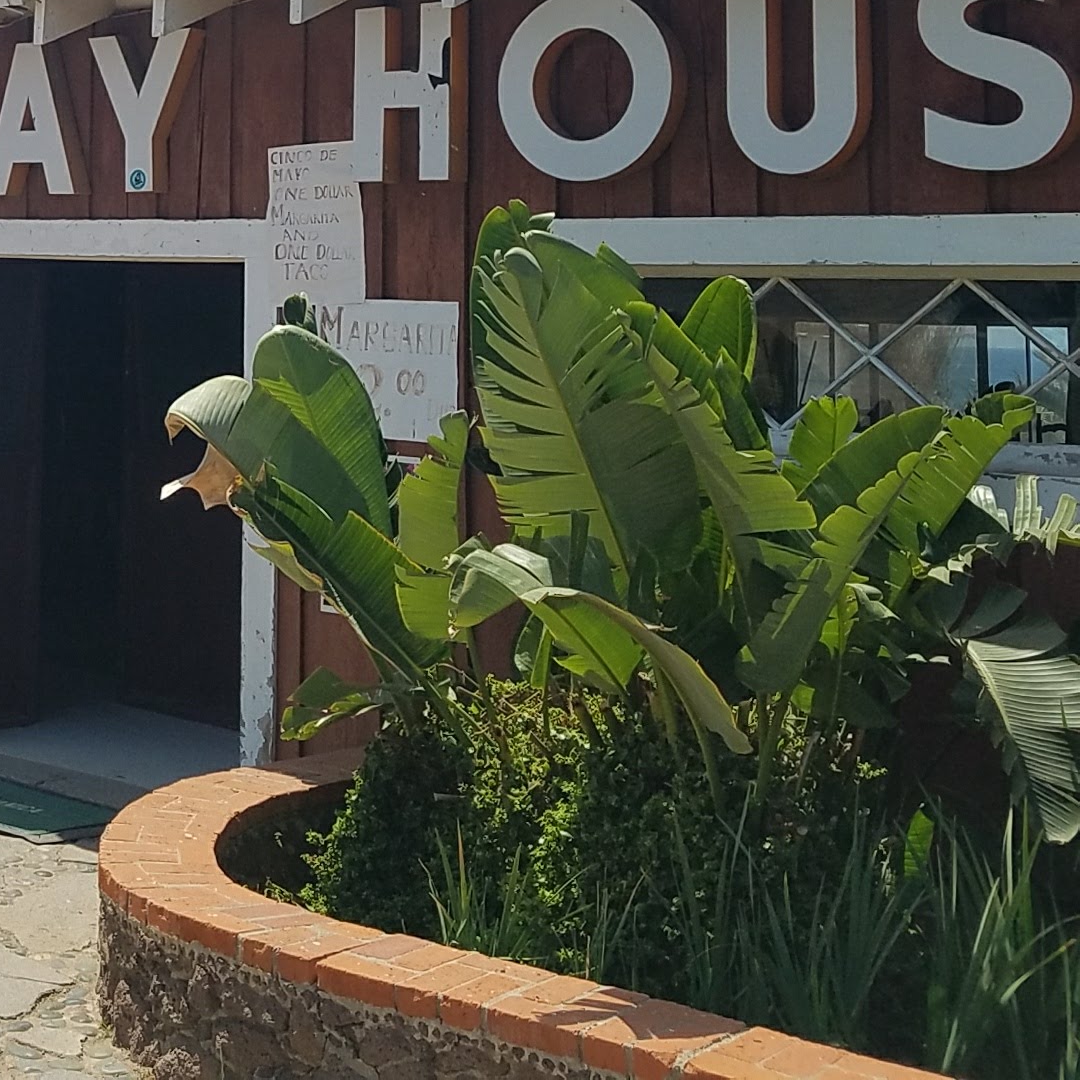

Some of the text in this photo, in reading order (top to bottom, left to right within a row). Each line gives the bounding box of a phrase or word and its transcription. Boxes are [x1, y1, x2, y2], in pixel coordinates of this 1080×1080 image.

[270, 149, 338, 166] CINCO DE
[314, 184, 354, 200] DOLLAR
[282, 228, 320, 241] AND
[274, 242, 309, 261] ONE
